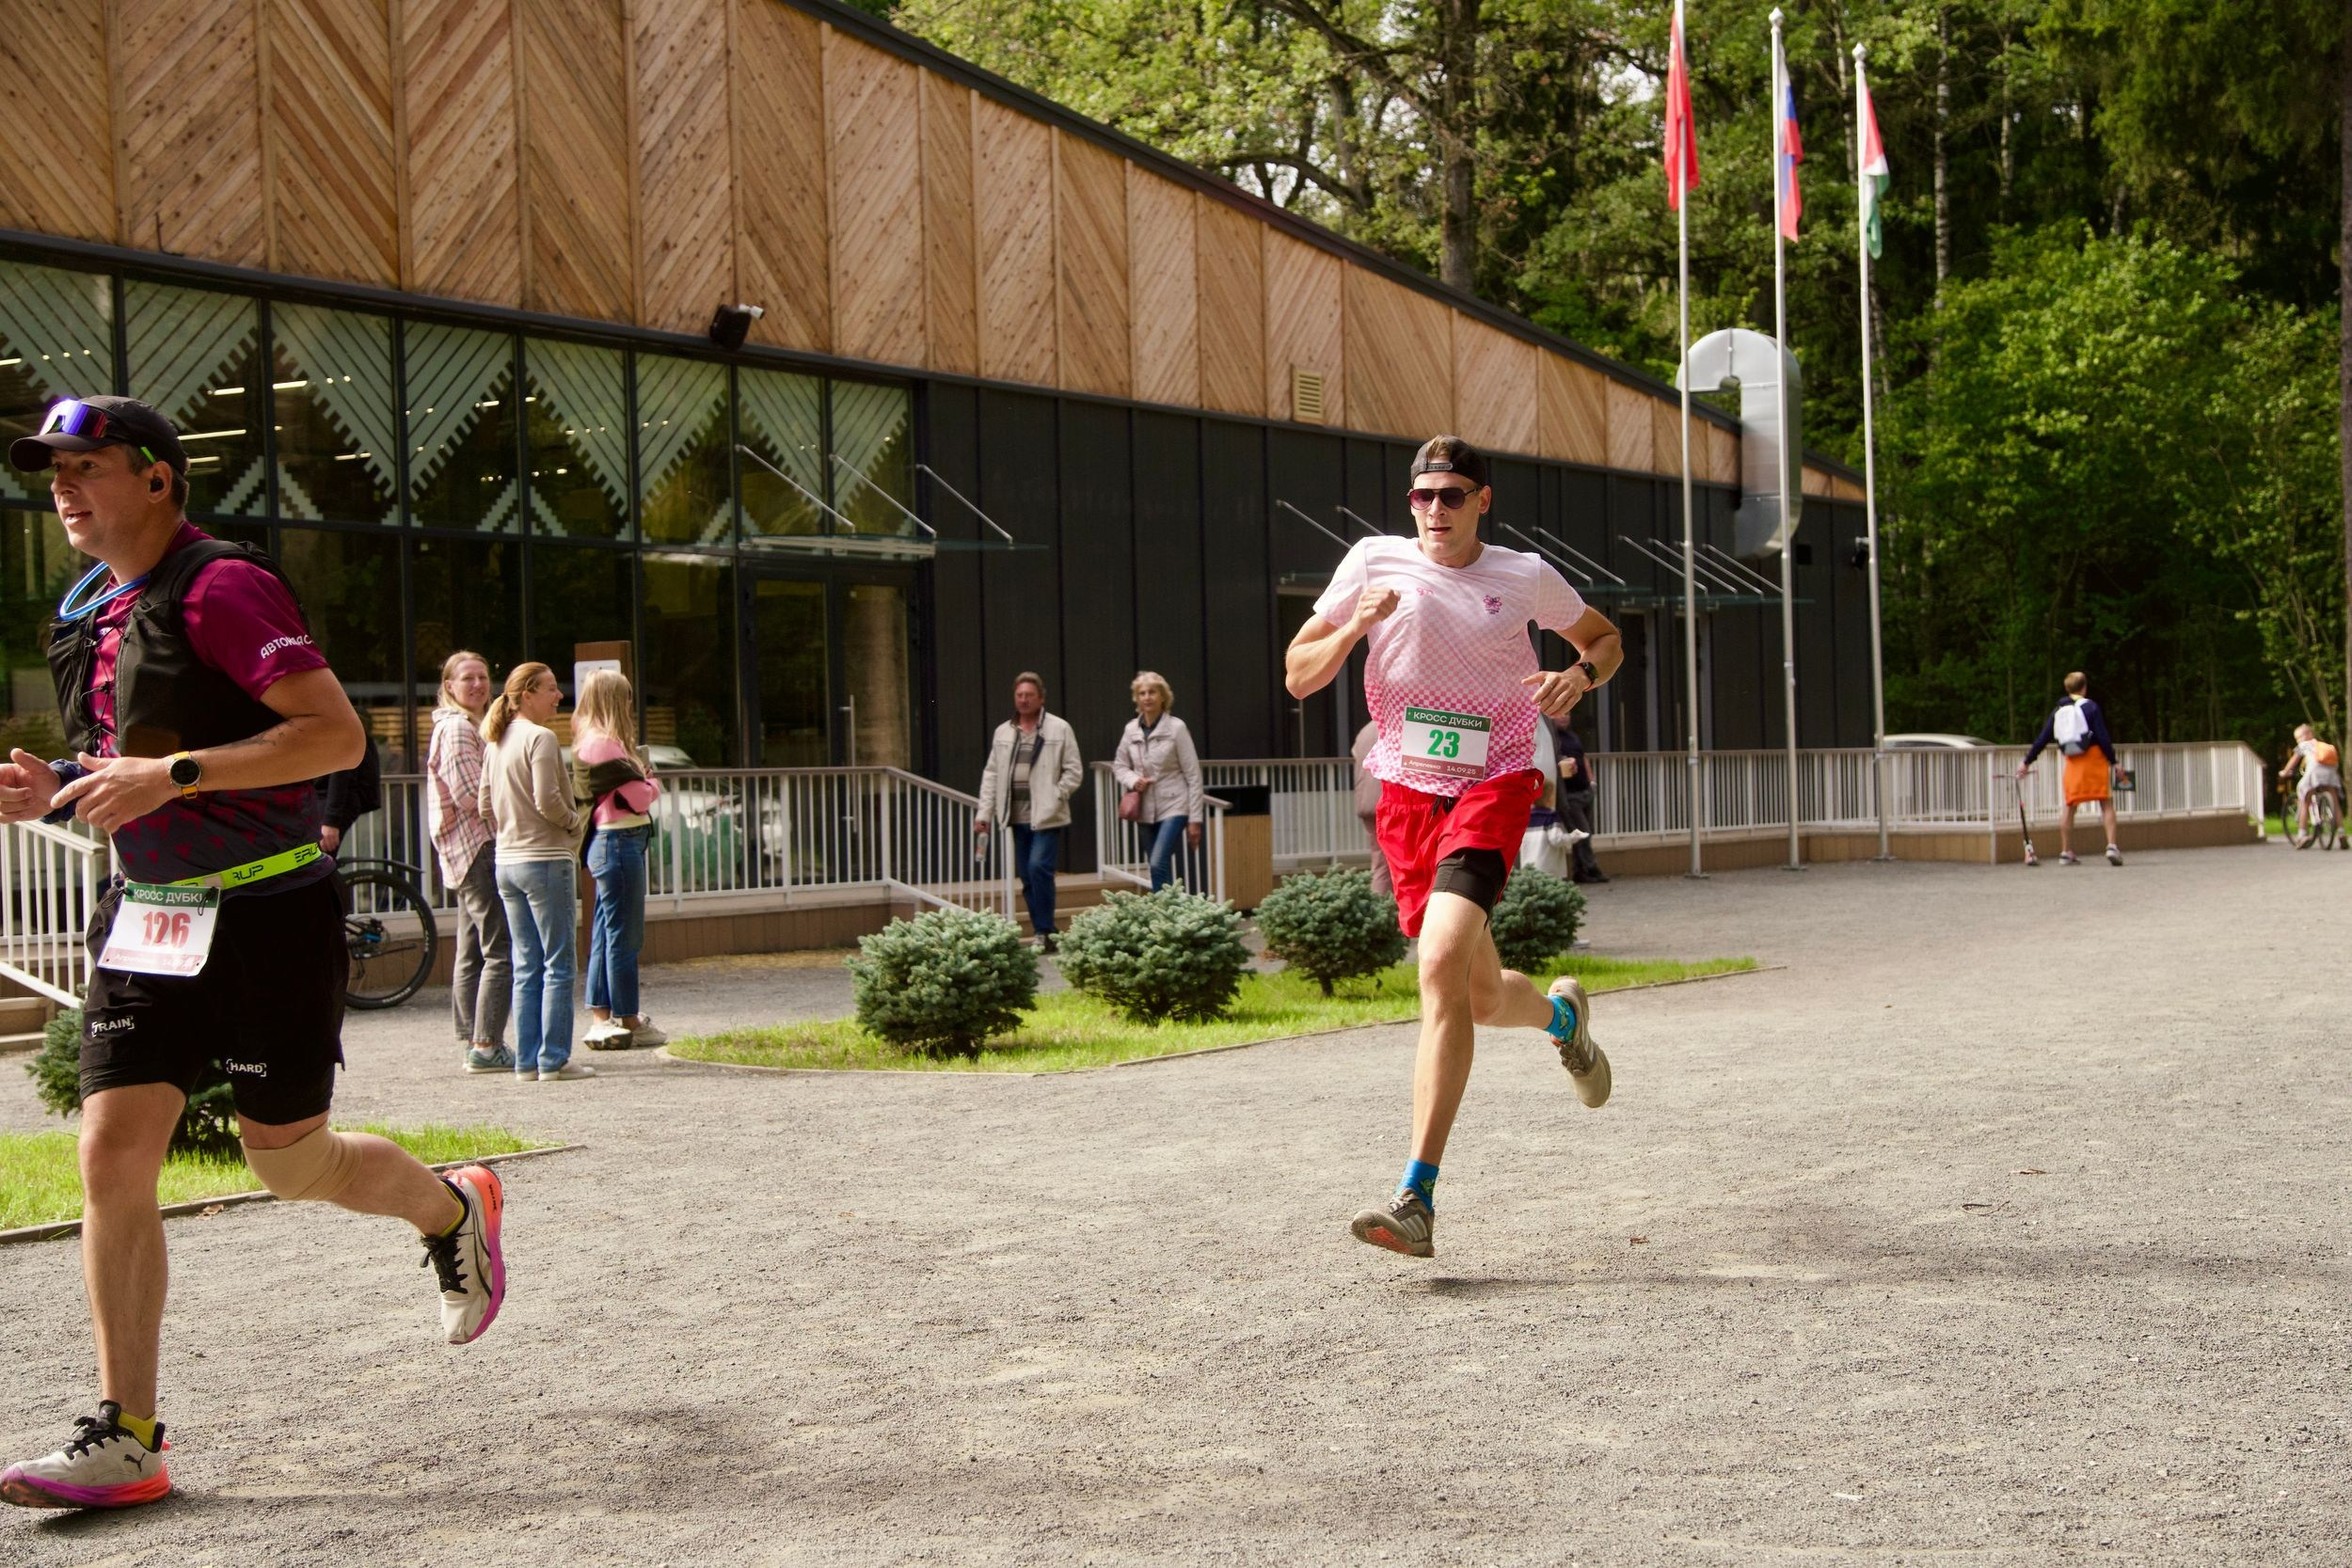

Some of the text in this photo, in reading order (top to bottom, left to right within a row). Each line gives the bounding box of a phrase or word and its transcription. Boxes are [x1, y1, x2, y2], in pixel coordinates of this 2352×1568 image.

[1413, 711, 1483, 728] КРОСС ДУБКИ
[1427, 729, 1460, 758] 23
[134, 889, 165, 902] КРОСС
[141, 911, 192, 949] 126
[230, 1062, 263, 1073] HARD
